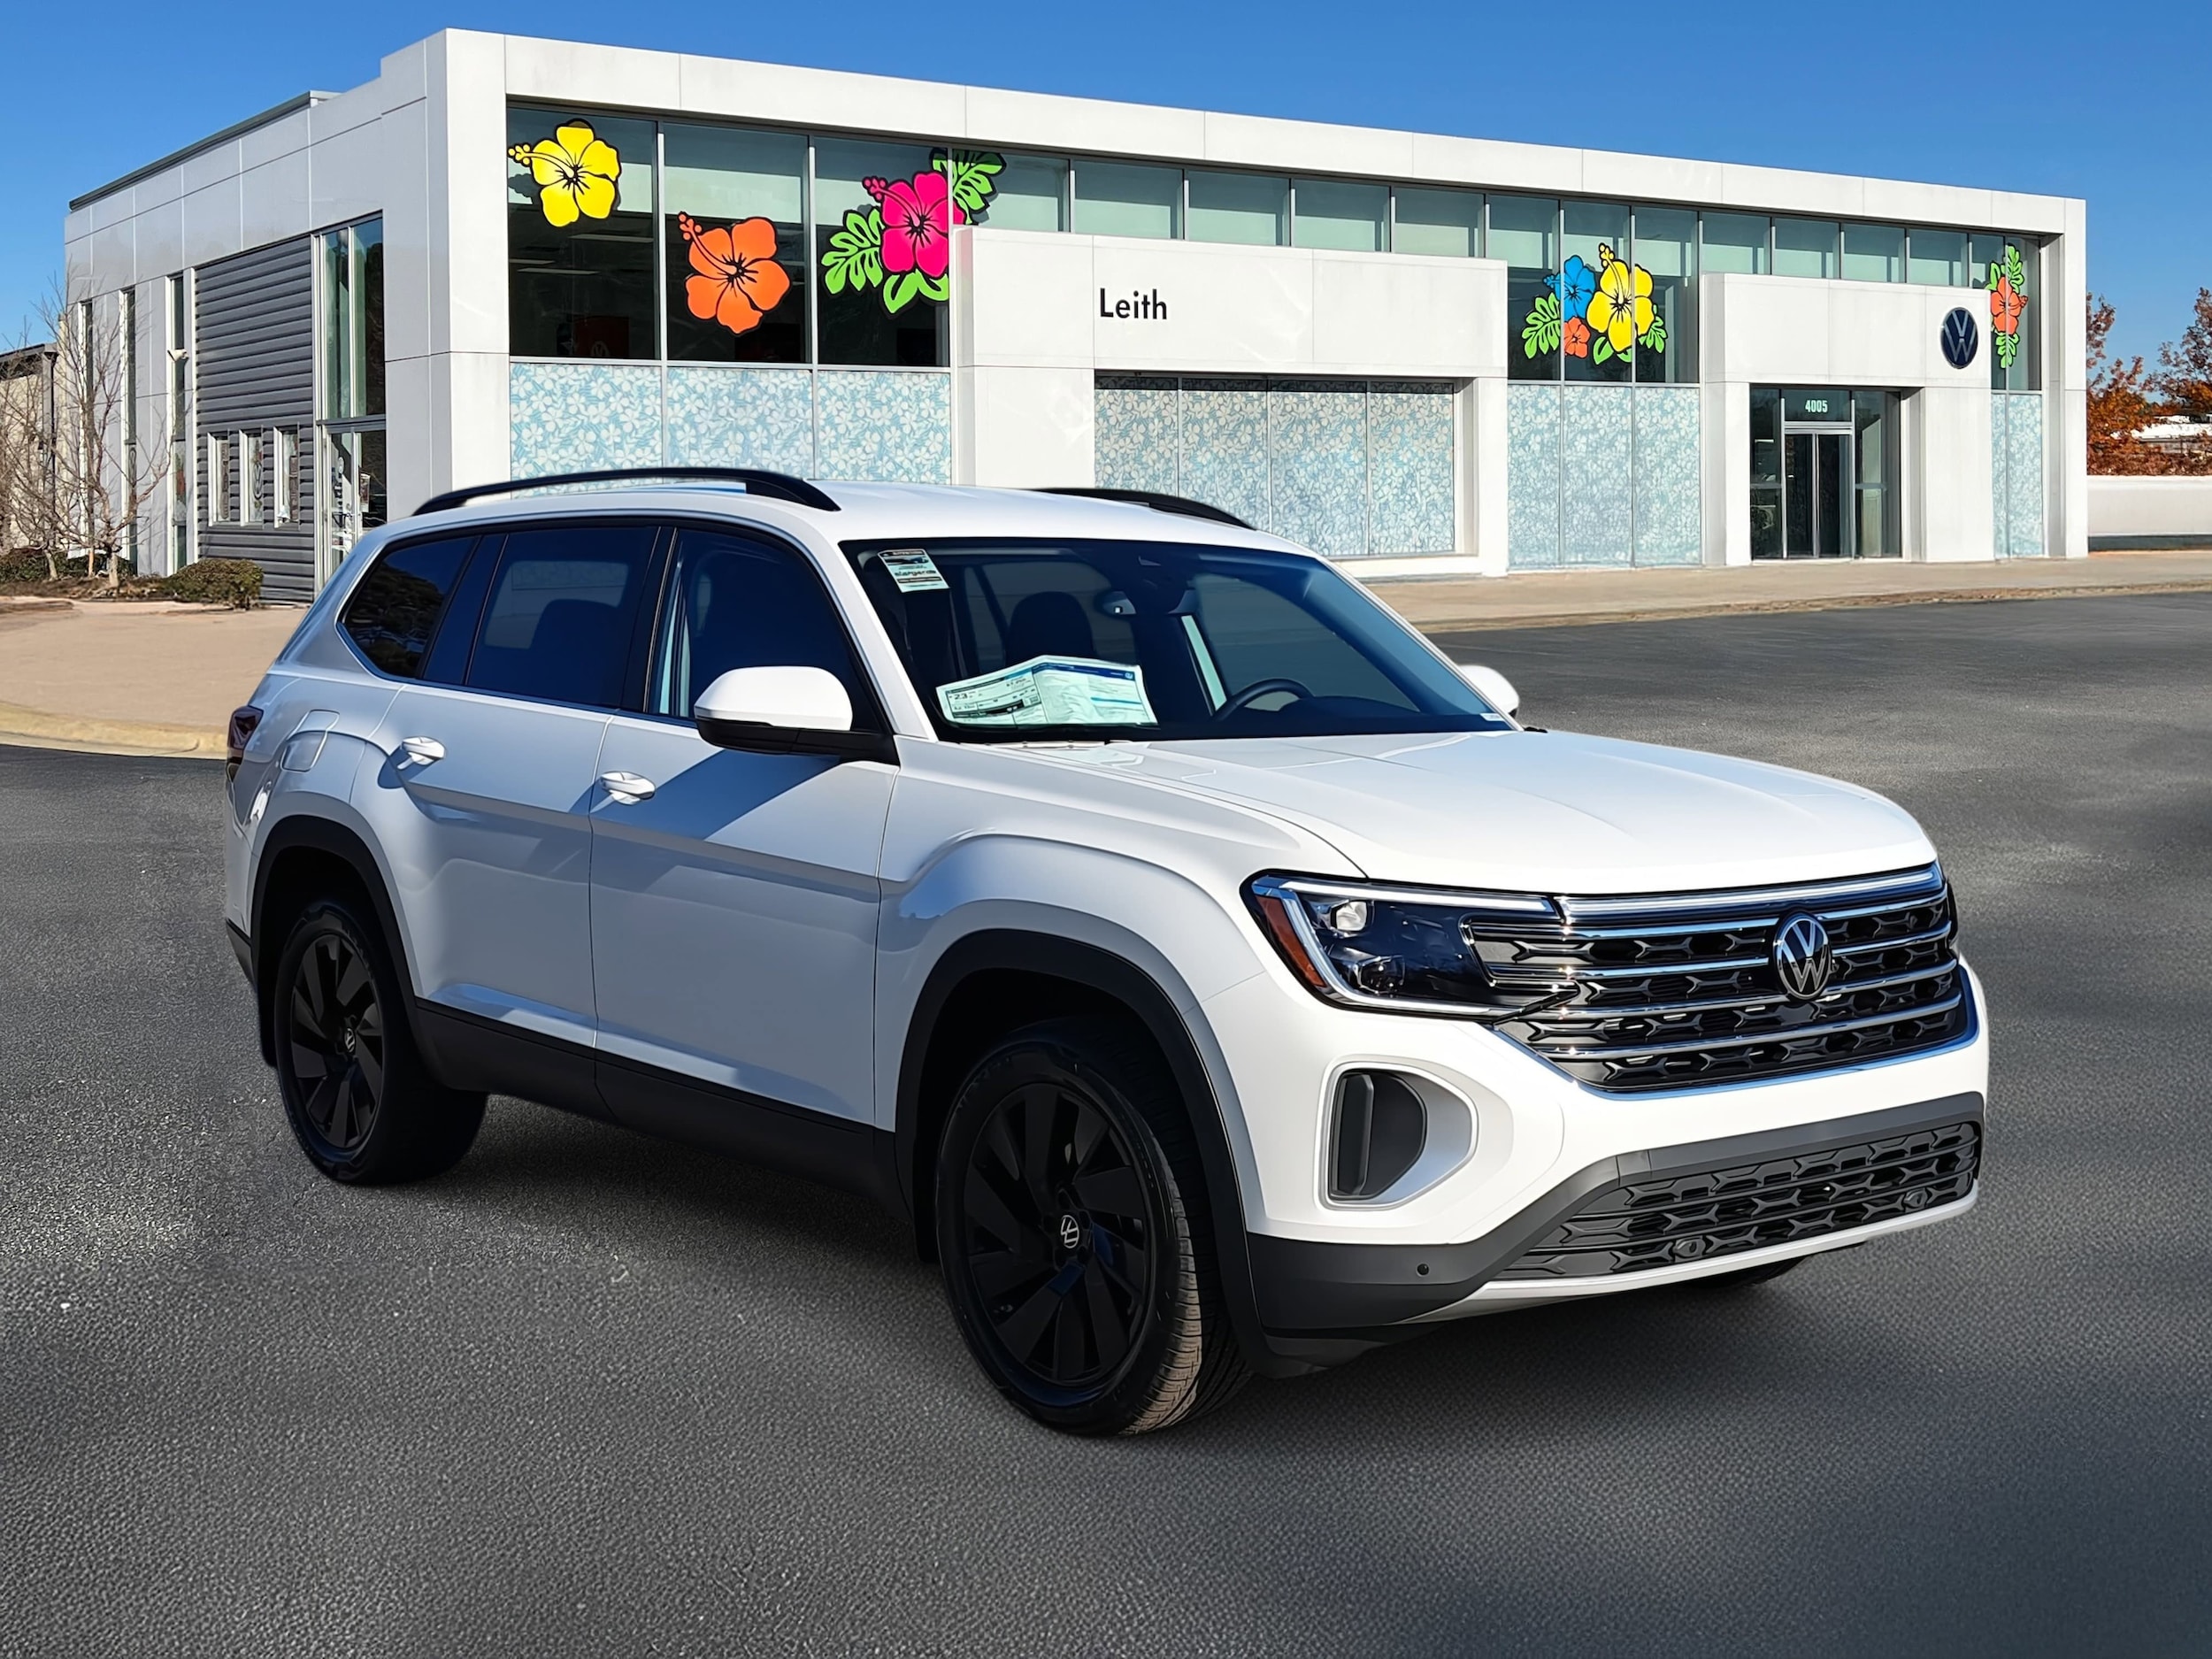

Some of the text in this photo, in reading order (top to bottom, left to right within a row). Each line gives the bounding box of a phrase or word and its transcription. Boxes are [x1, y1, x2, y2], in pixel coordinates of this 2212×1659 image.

[1100, 288, 1167, 319] Leith
[1942, 309, 1977, 364] VW
[1805, 399, 1828, 413] 4005
[1777, 918, 1828, 994] VW
